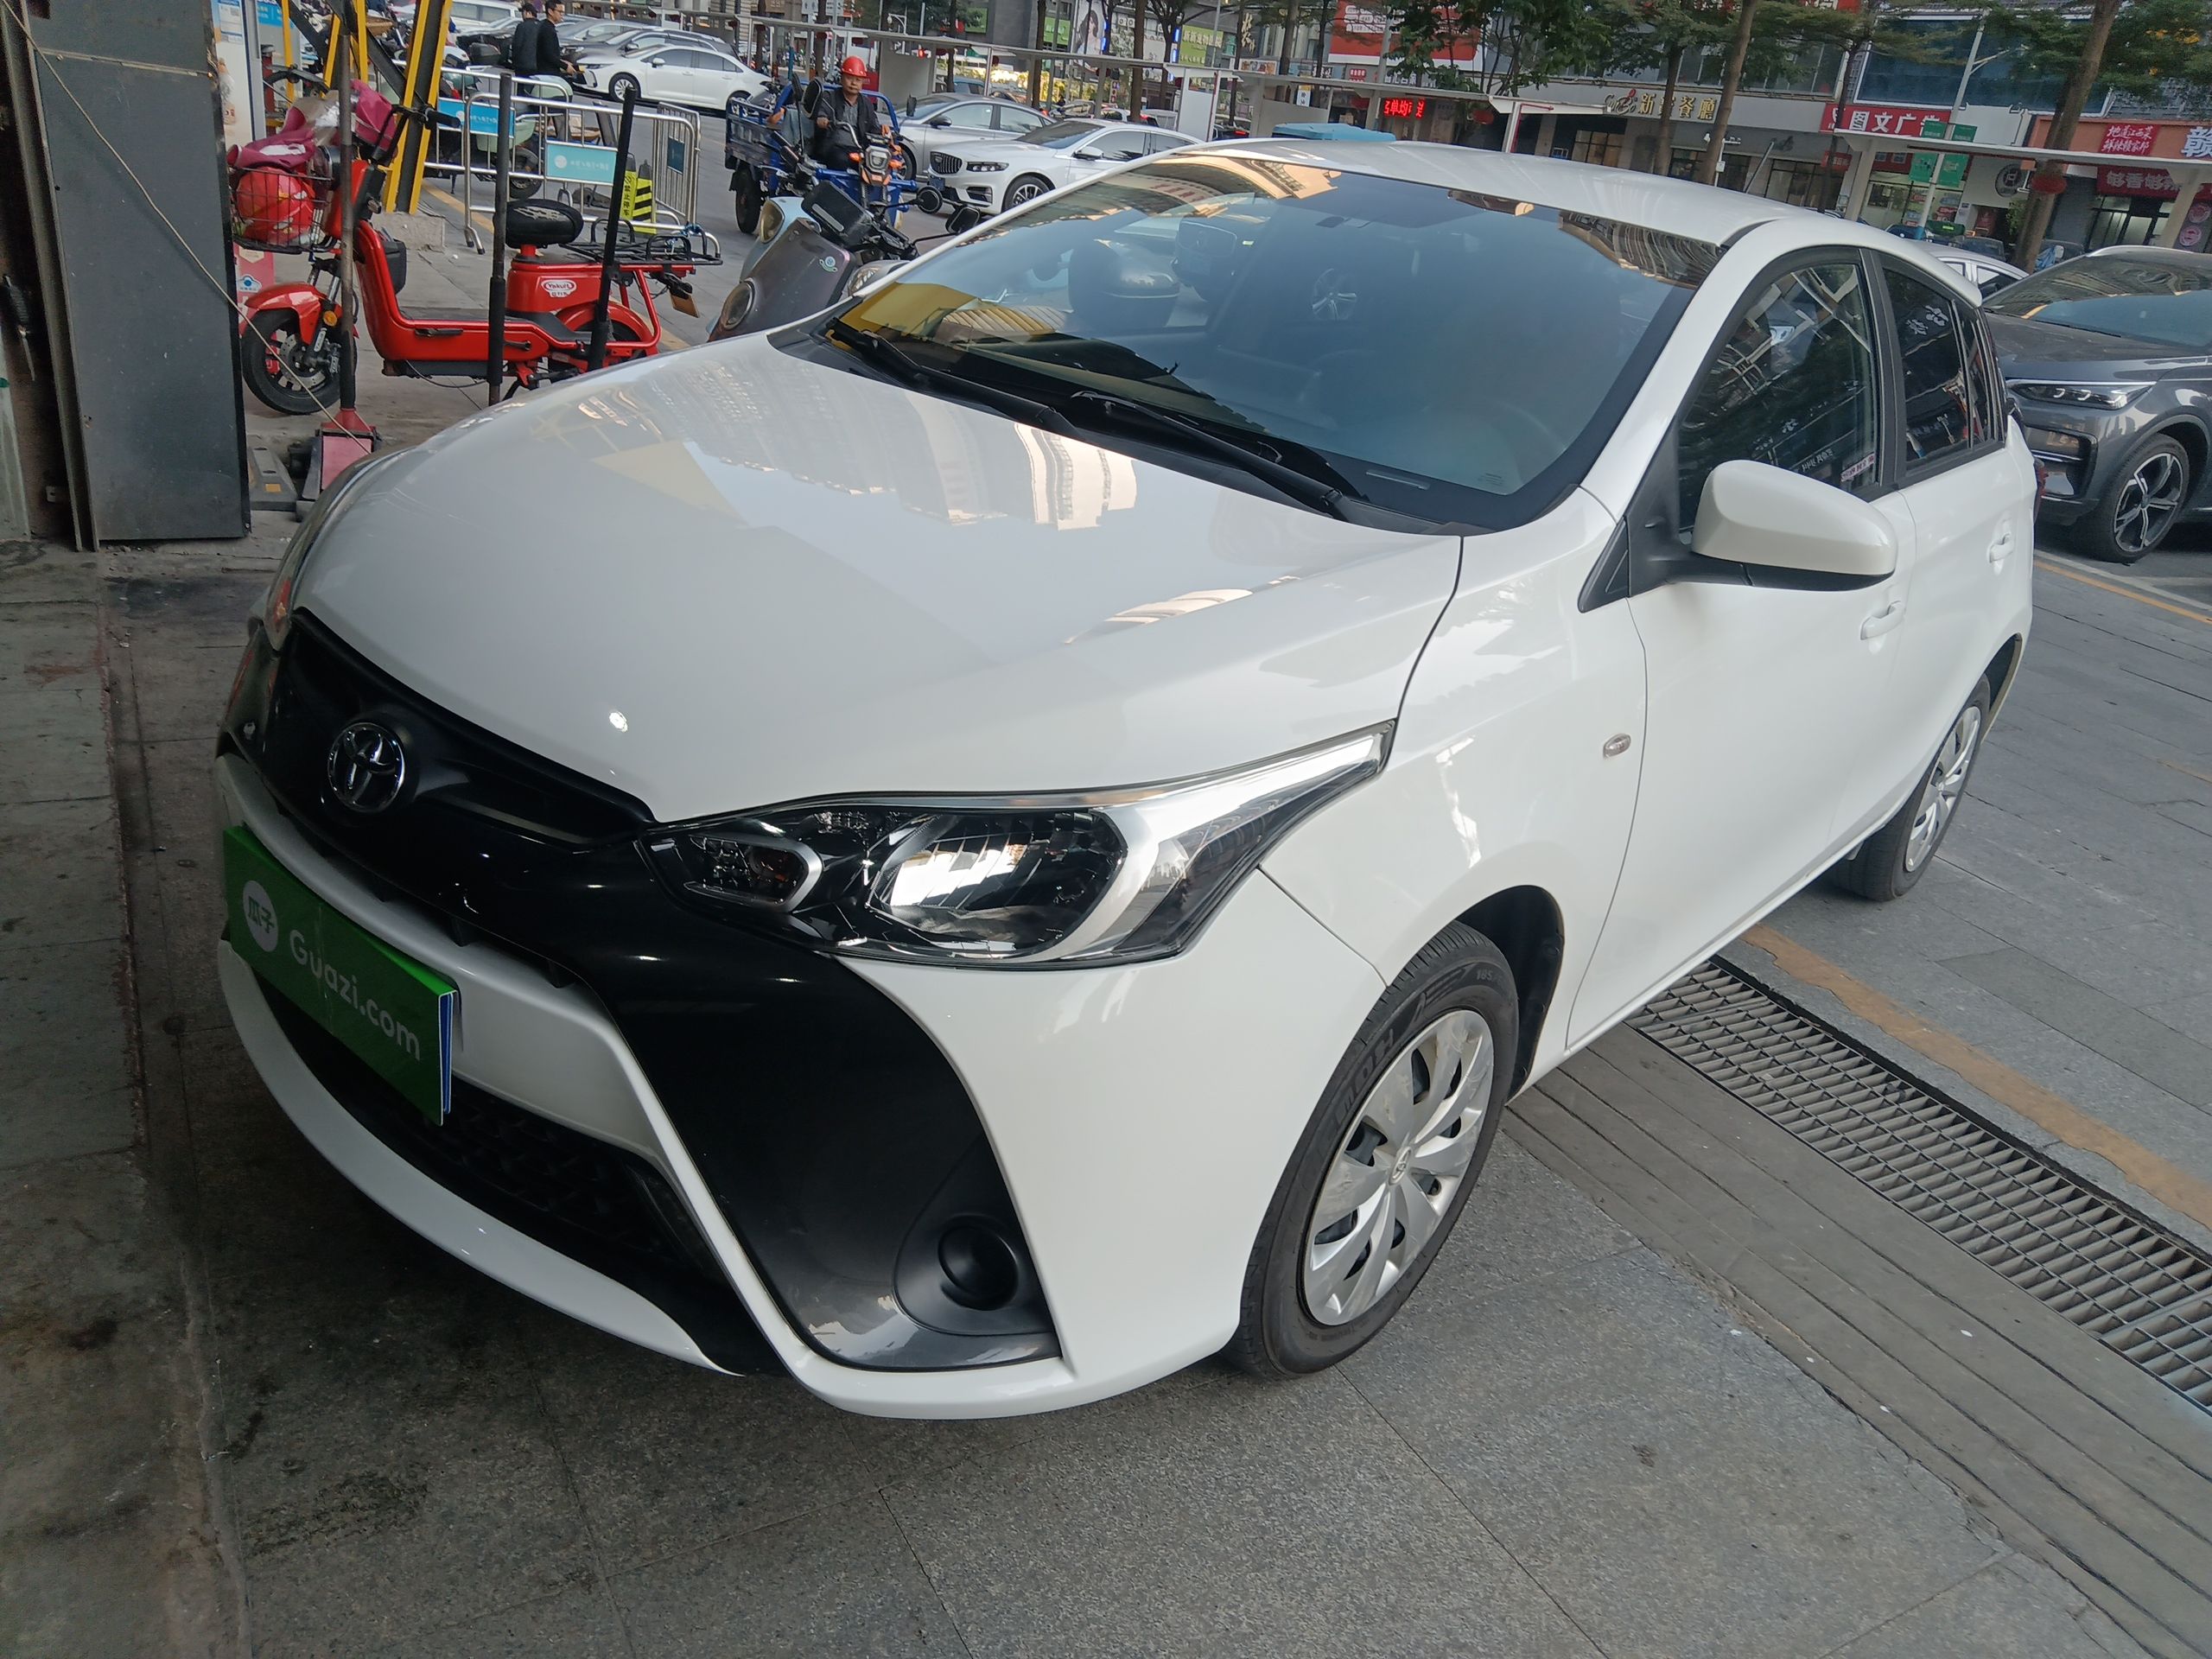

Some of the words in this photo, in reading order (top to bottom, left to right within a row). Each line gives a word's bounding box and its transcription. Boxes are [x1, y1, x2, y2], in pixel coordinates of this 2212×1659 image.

[1638, 93, 1717, 120] 新餐廳
[246, 896, 276, 935] 瓜子
[289, 928, 421, 1062] Guazi.com
